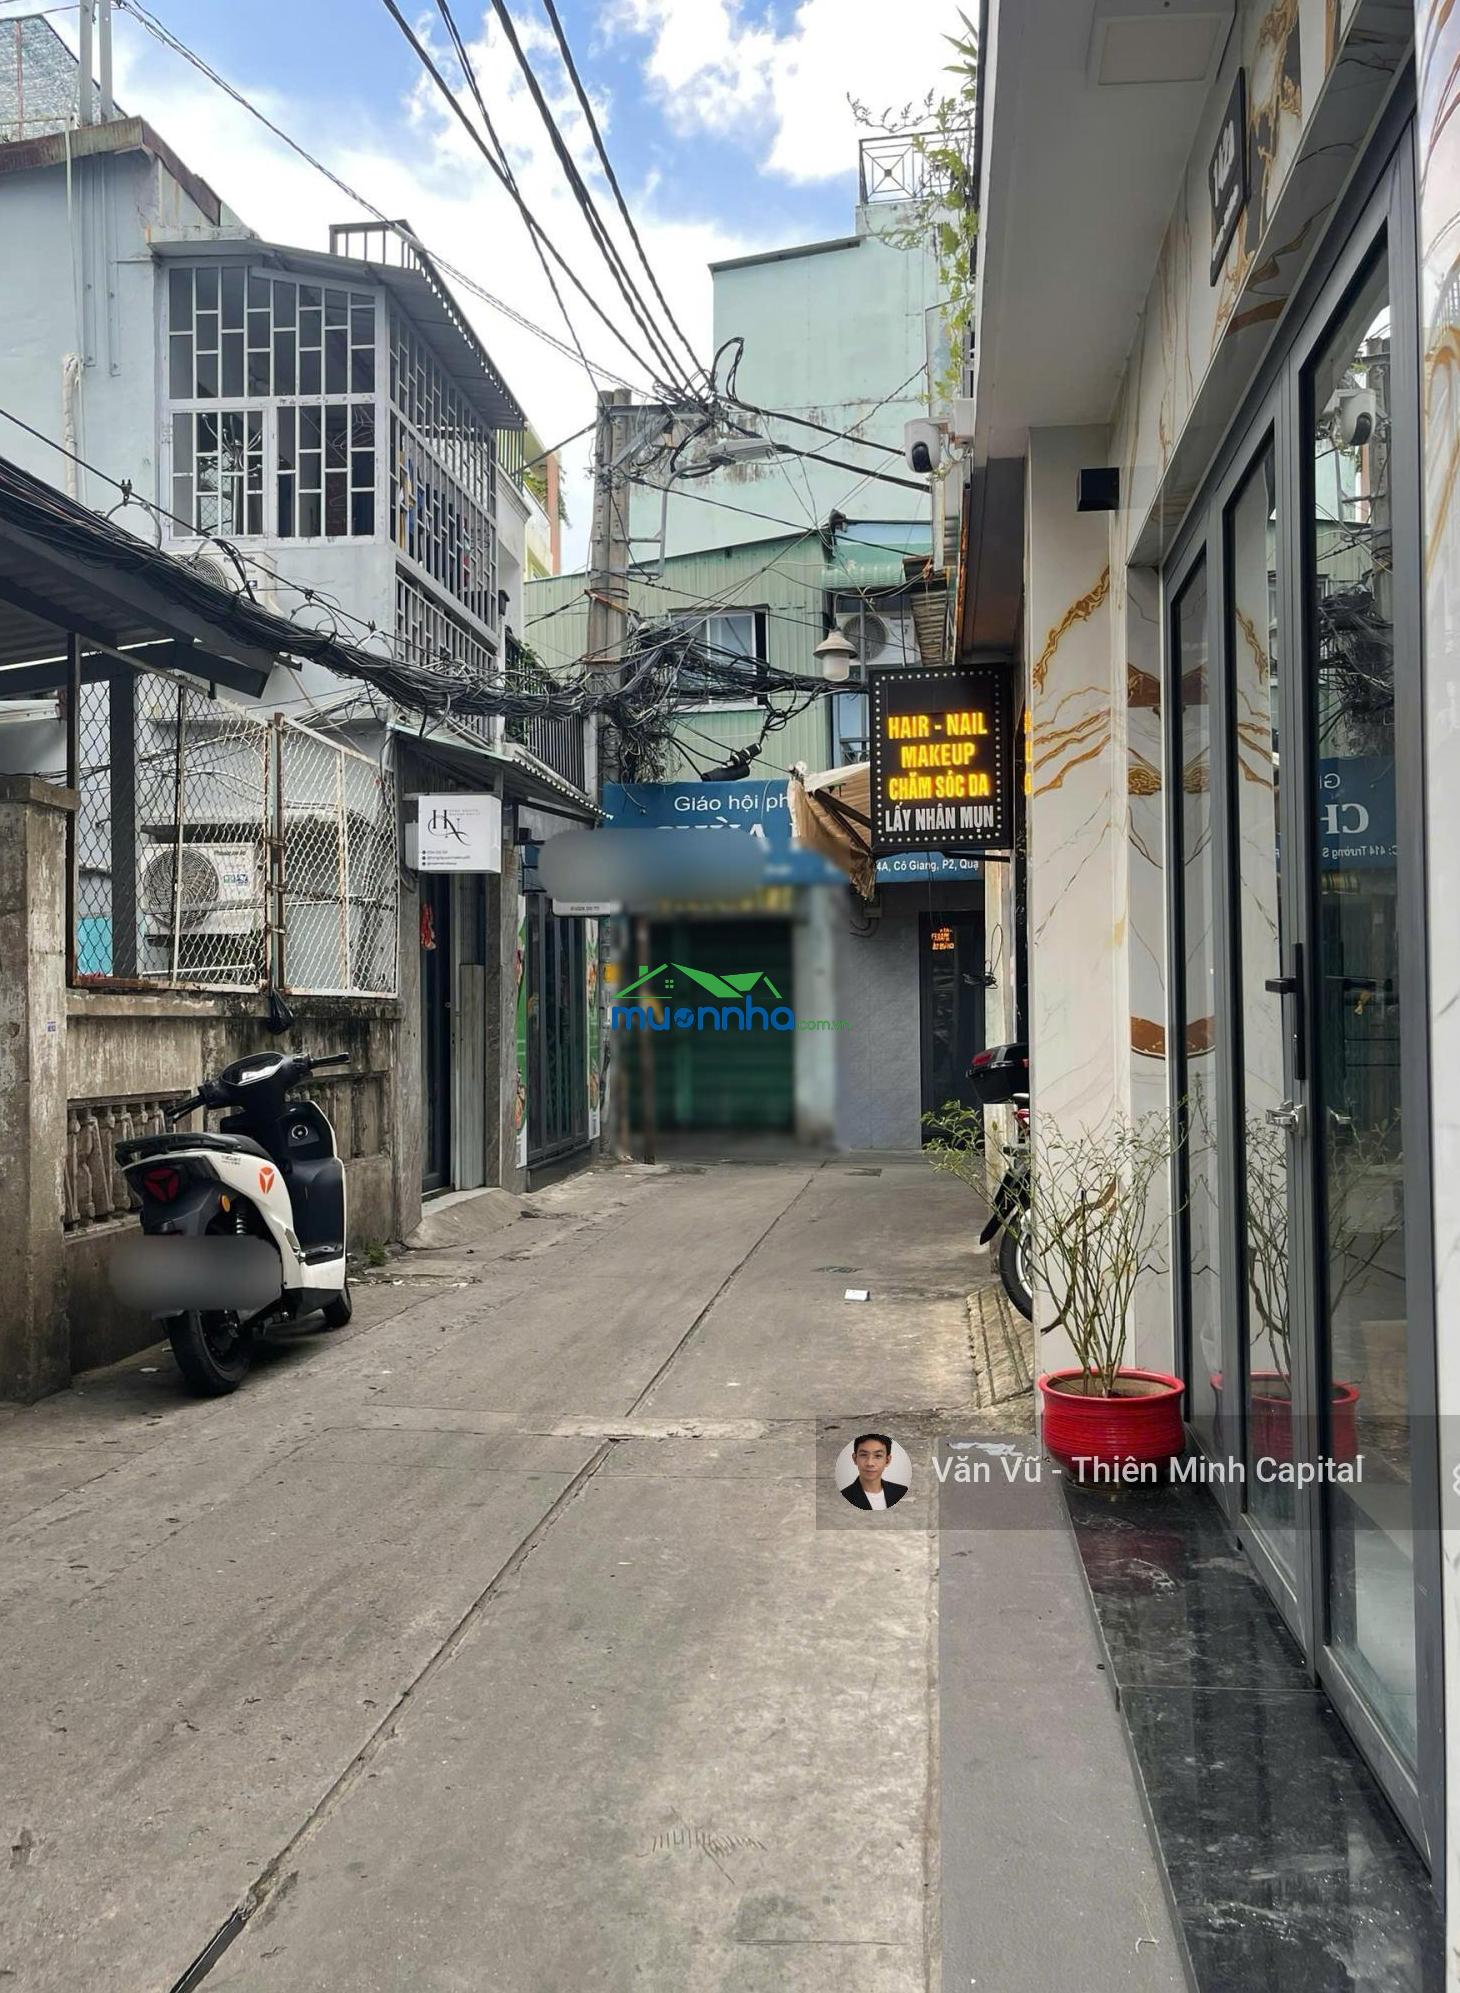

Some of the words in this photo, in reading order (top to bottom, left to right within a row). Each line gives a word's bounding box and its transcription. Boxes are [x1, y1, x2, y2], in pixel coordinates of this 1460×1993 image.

[888, 715, 929, 739] HAIR
[945, 712, 988, 736] NAIL
[901, 742, 976, 768] MAKEUP
[889, 771, 932, 801] CHĂM
[935, 769, 966, 798] SÓC
[968, 773, 990, 797] DA
[674, 796, 722, 811] Giáo
[728, 794, 759, 812] hội
[885, 801, 912, 832] LẤY
[915, 802, 956, 831] NHÂN
[960, 805, 994, 833] MỤN
